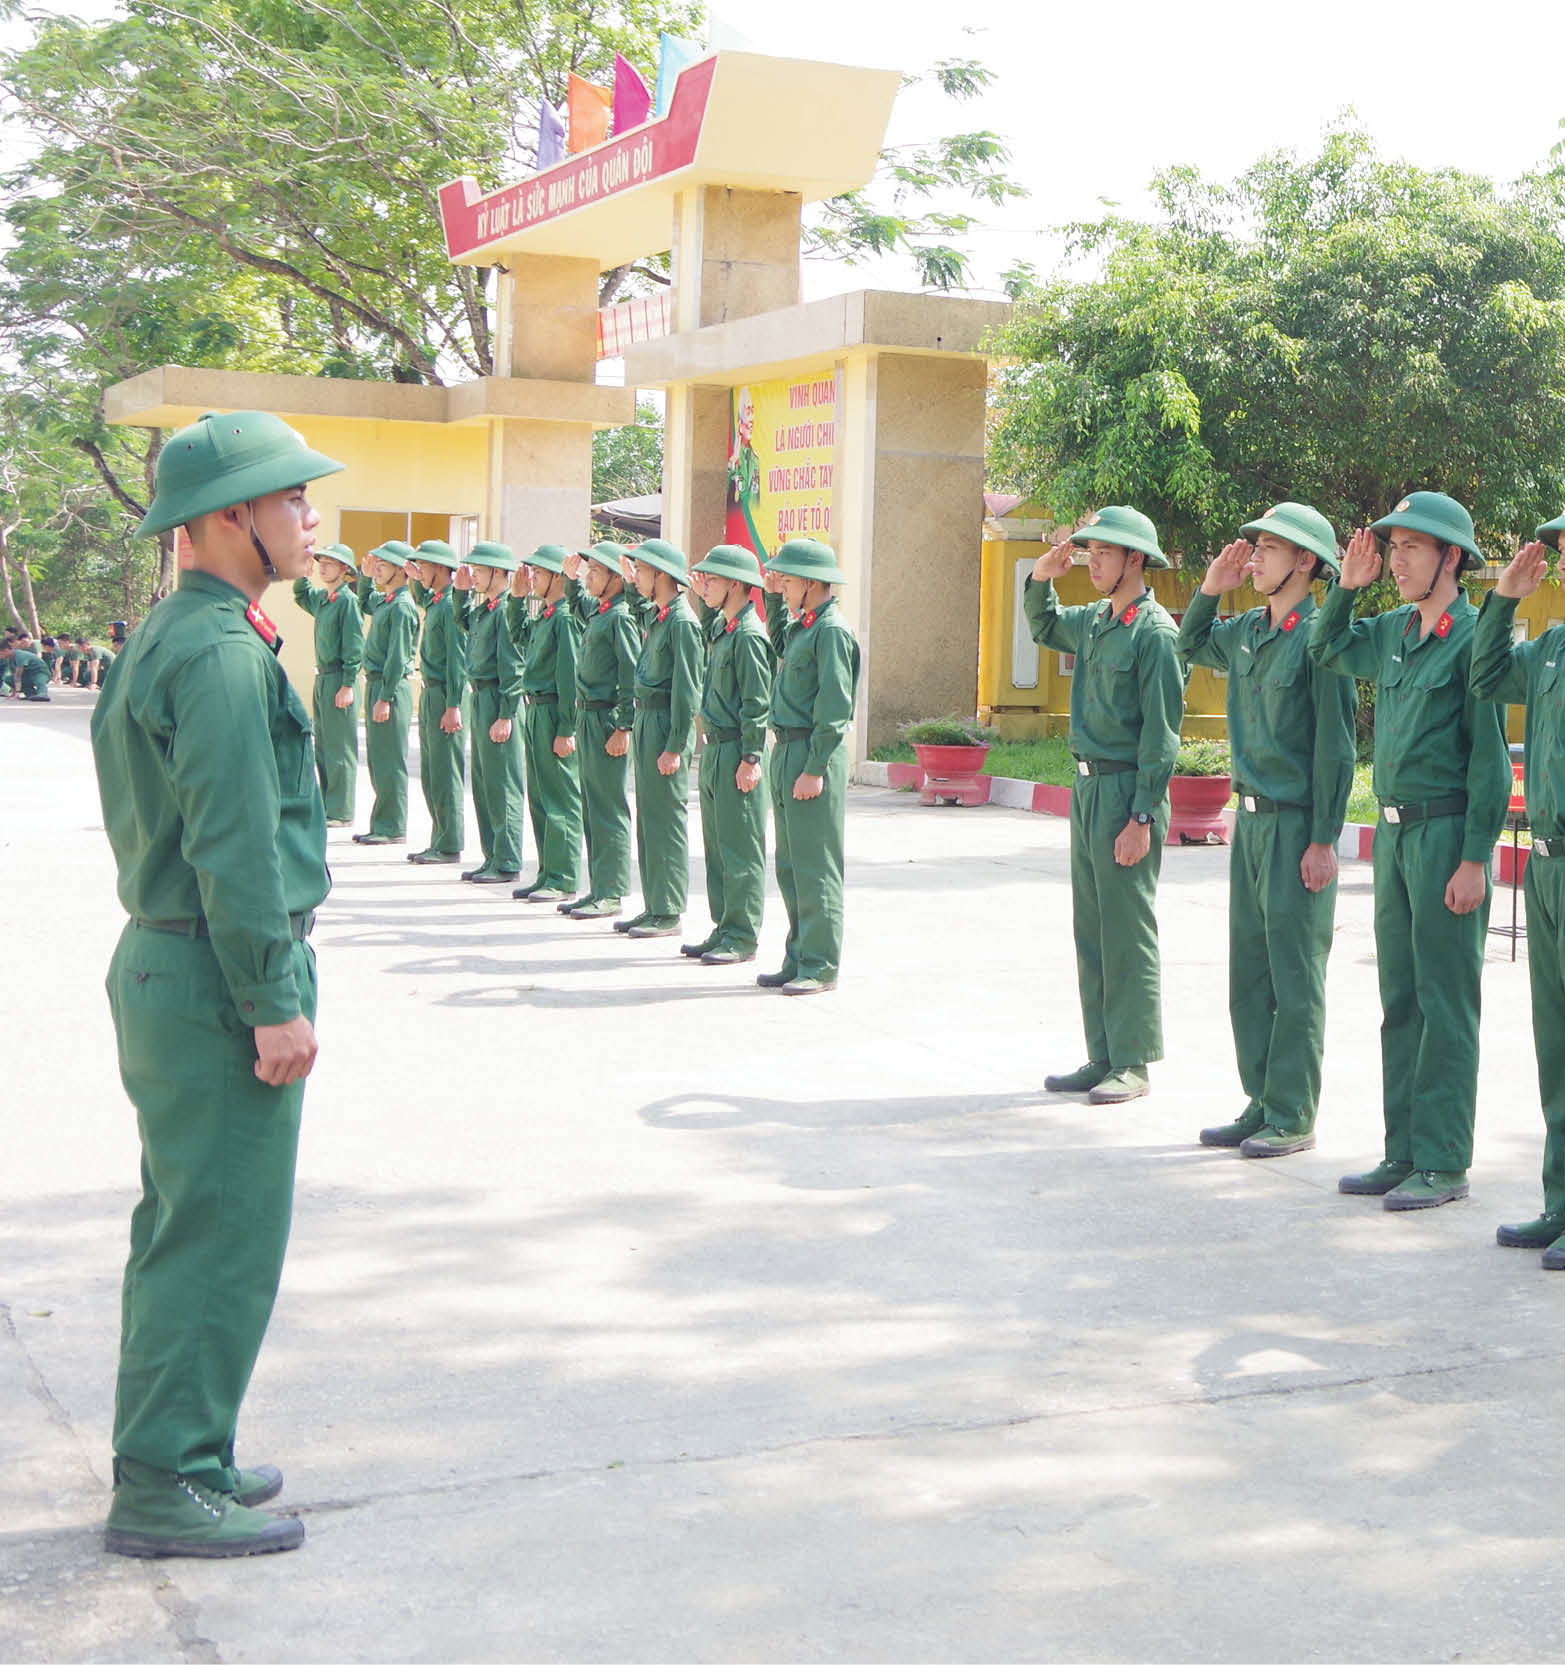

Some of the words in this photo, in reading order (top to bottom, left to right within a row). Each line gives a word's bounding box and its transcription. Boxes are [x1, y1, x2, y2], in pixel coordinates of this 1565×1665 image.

[490, 197, 510, 236] LUẬT
[512, 189, 524, 227] LÀ
[548, 175, 575, 216] MẠNH
[578, 157, 598, 200] CỦA
[602, 148, 629, 193] QUÂN
[633, 136, 653, 183] ĐỘI
[789, 384, 809, 408] VINH
[776, 424, 785, 452] LÀ
[788, 419, 815, 450] NGƯỜI
[819, 464, 833, 489] TAY
[824, 505, 832, 533] Q
